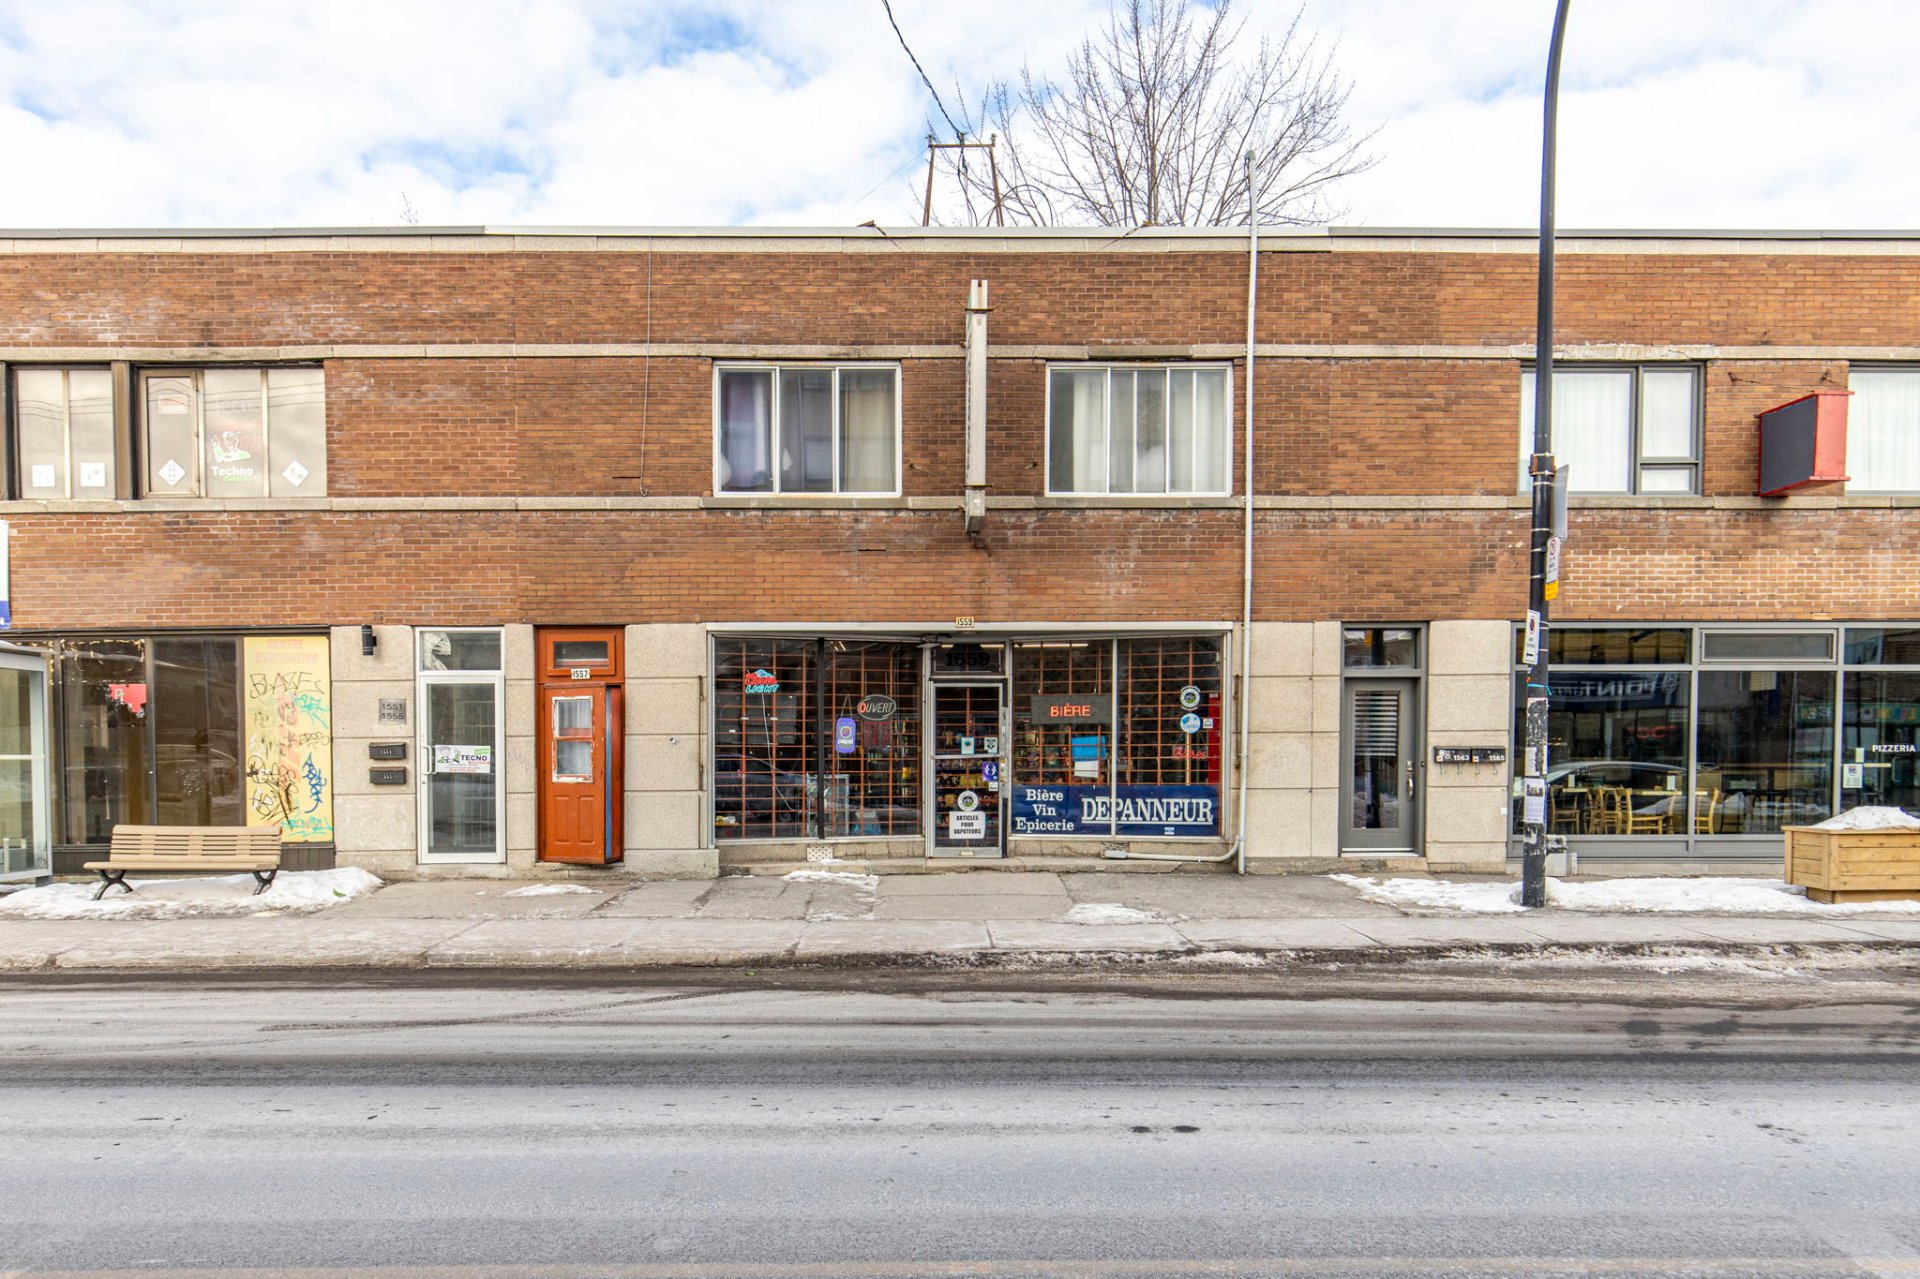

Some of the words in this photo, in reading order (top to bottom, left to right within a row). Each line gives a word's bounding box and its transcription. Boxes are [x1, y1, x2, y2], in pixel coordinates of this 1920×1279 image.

[211, 466, 254, 476] Techno
[957, 618, 973, 626] 1559
[944, 652, 991, 667] 1559
[573, 670, 588, 678] 1557
[382, 703, 403, 711] 1551
[859, 702, 894, 714] OUVERT
[1050, 702, 1091, 717] BIÈRE
[382, 712, 404, 720] 1555
[1872, 744, 1917, 753] PIZZERIA
[1025, 788, 1064, 802] Bière
[1032, 804, 1057, 816] Vin
[1015, 817, 1075, 833] Epicerie
